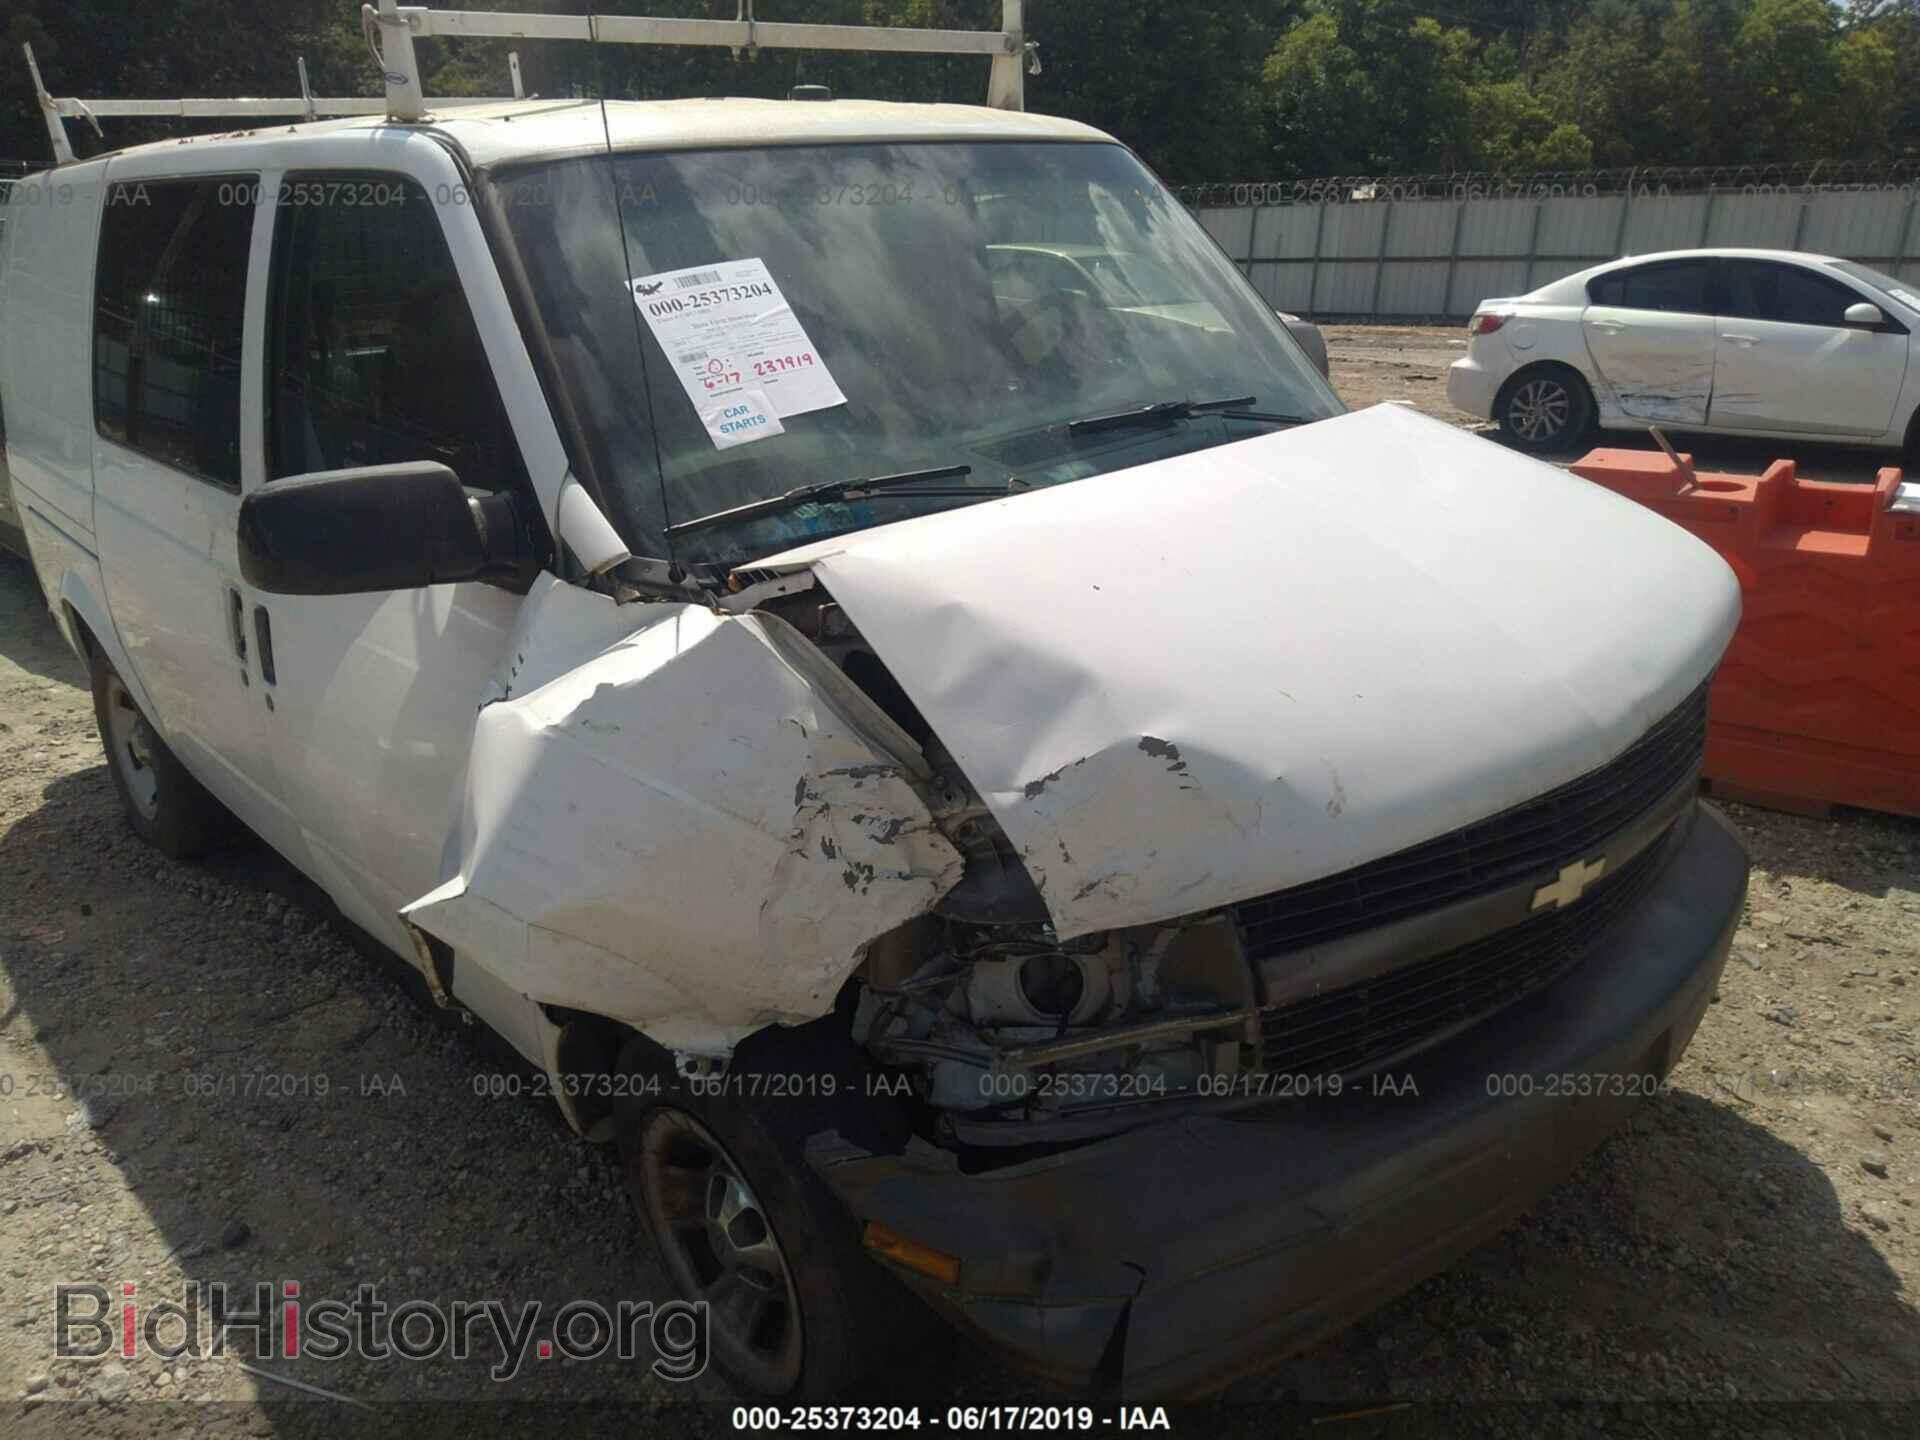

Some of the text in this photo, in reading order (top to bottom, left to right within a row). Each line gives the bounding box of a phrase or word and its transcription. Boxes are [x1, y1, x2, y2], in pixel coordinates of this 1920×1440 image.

[649, 282, 773, 316] 000-25373204
[704, 371, 741, 389] 6-17
[723, 405, 749, 418] CAR
[720, 415, 767, 434] STARTS
